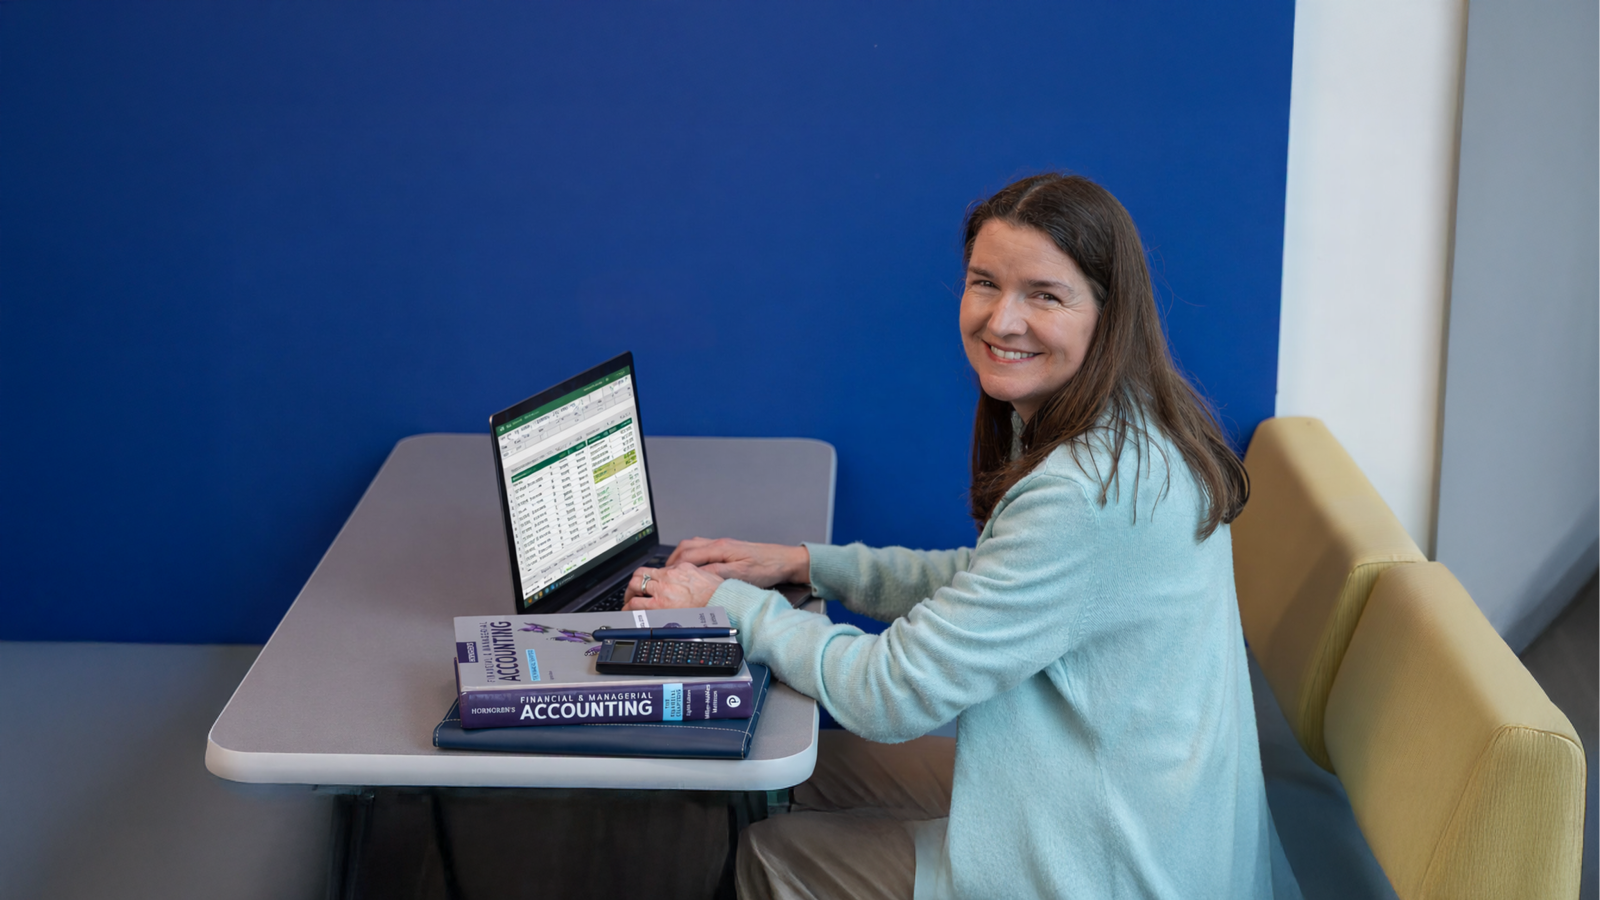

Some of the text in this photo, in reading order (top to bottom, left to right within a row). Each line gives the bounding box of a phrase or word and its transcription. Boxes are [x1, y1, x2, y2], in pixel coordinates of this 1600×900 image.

[490, 621, 521, 682] ACCOUNTING
[520, 692, 653, 704] FINANCIAL & MANAGERIAL
[471, 706, 516, 715] HORNGREN'S
[520, 700, 653, 720] ACCOUNTING
